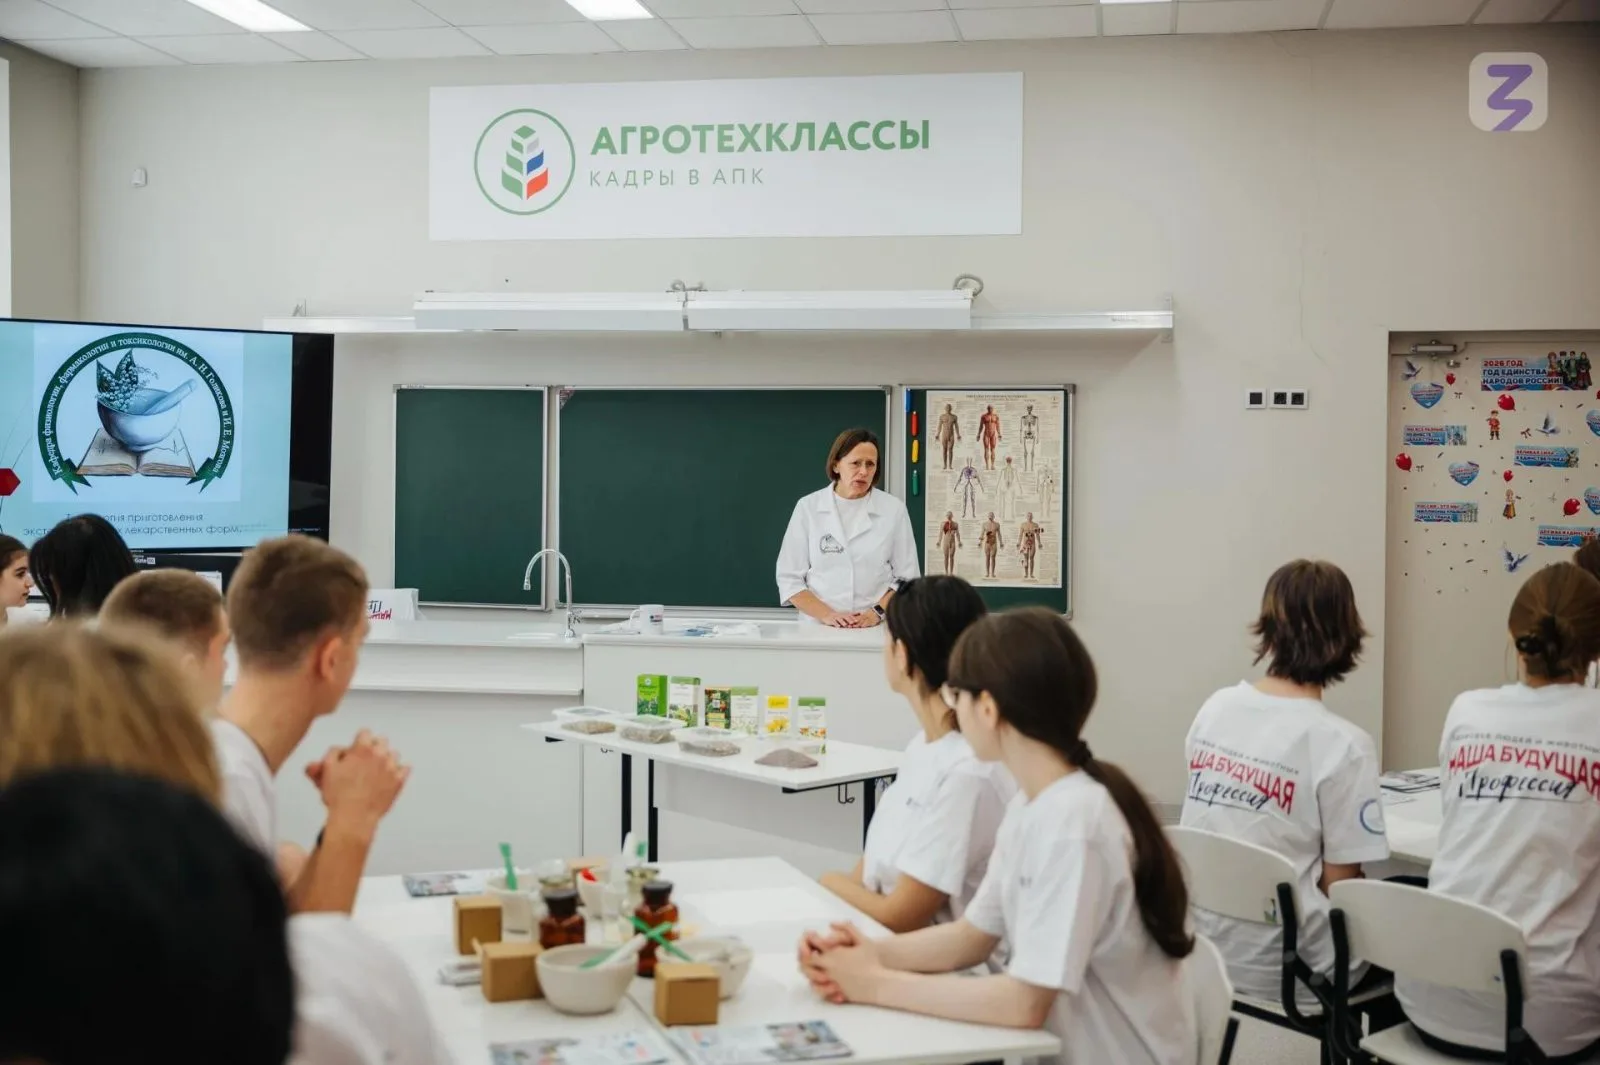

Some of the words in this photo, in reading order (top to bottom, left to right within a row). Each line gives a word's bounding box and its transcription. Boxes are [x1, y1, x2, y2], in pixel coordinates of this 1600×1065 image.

[590, 119, 930, 155] АГРОТЕХКЛАССЫ
[589, 169, 674, 189] КАДРЫ
[688, 168, 700, 186] В
[712, 167, 764, 185] АПК
[110, 340, 117, 348] и
[119, 337, 176, 352] токсикологии
[176, 346, 188, 359] им.
[58, 342, 109, 384] фармакологии
[189, 355, 198, 367] А.
[1506, 360, 1524, 368] ГОД
[198, 363, 208, 375] Н.
[1482, 368, 1500, 376] ГОД
[1501, 368, 1547, 376] ЕДИНСТВА
[1482, 377, 1525, 385] НАРОДОВ
[1525, 376, 1563, 385] РОССИИ!
[205, 372, 227, 409] Голикова
[42, 385, 63, 436] физиологии,
[46, 438, 63, 475] Кафедра
[213, 439, 231, 473] Мозгова
[127, 512, 204, 523] приготовления
[124, 525, 204, 536] лекарственных
[1500, 745, 1600, 800] БУДУЩАЯ
[1190, 750, 1215, 770] ША
[1215, 757, 1295, 815] БУДУЩАЯ
